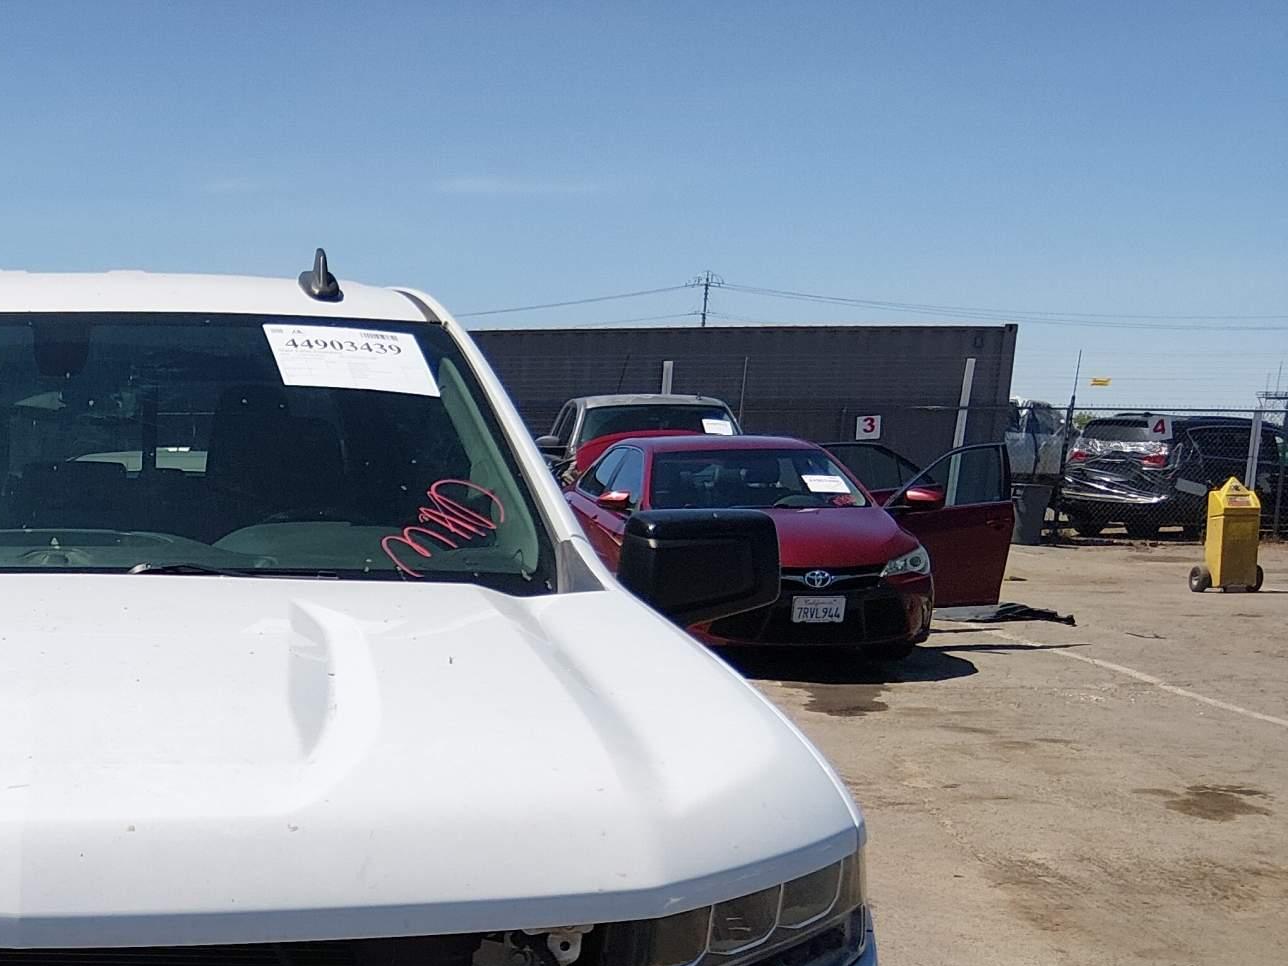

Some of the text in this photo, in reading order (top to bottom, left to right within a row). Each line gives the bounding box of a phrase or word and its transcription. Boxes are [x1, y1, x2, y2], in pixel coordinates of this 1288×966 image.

[284, 338, 403, 355] 44903439
[862, 417, 876, 433] 3
[1152, 419, 1166, 434] 4
[796, 607, 841, 619] 7RVL944
